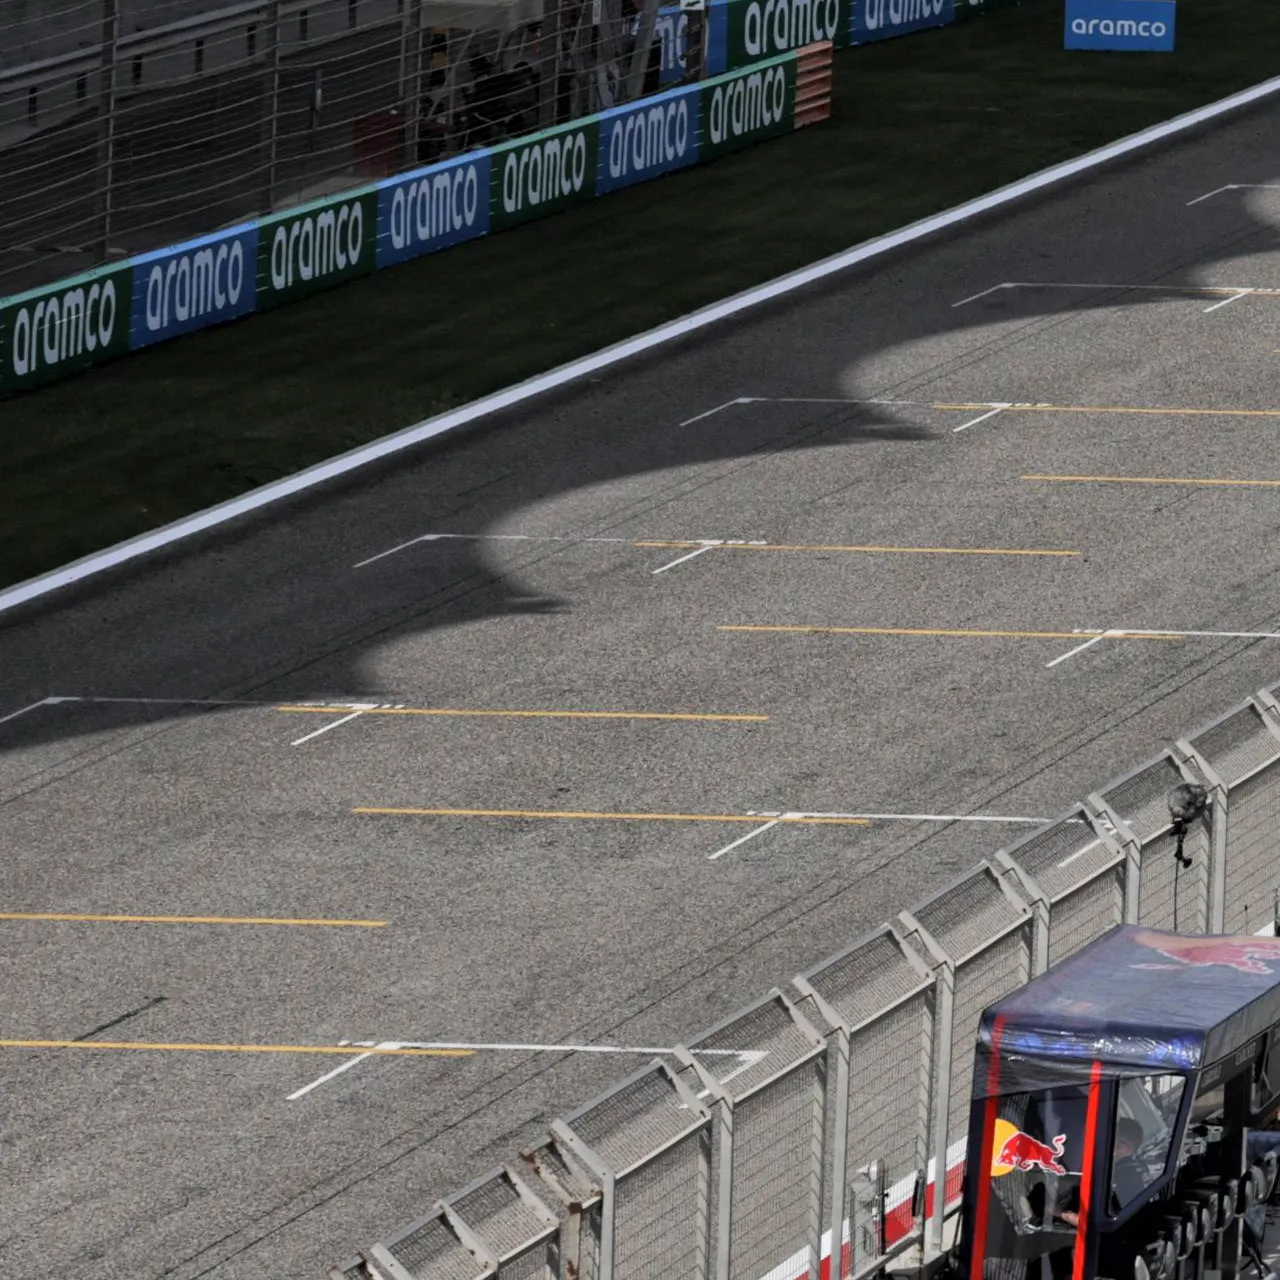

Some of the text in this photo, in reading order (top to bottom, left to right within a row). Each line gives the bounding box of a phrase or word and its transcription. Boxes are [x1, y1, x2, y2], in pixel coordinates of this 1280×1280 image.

[1071, 17, 1167, 38] aramco
[609, 98, 688, 179] aramco
[710, 65, 786, 145] aramco
[390, 163, 478, 251] aramco
[503, 131, 588, 214] aramco
[147, 239, 244, 332] aramco
[271, 201, 363, 290] aramco
[13, 277, 116, 376] aramco
